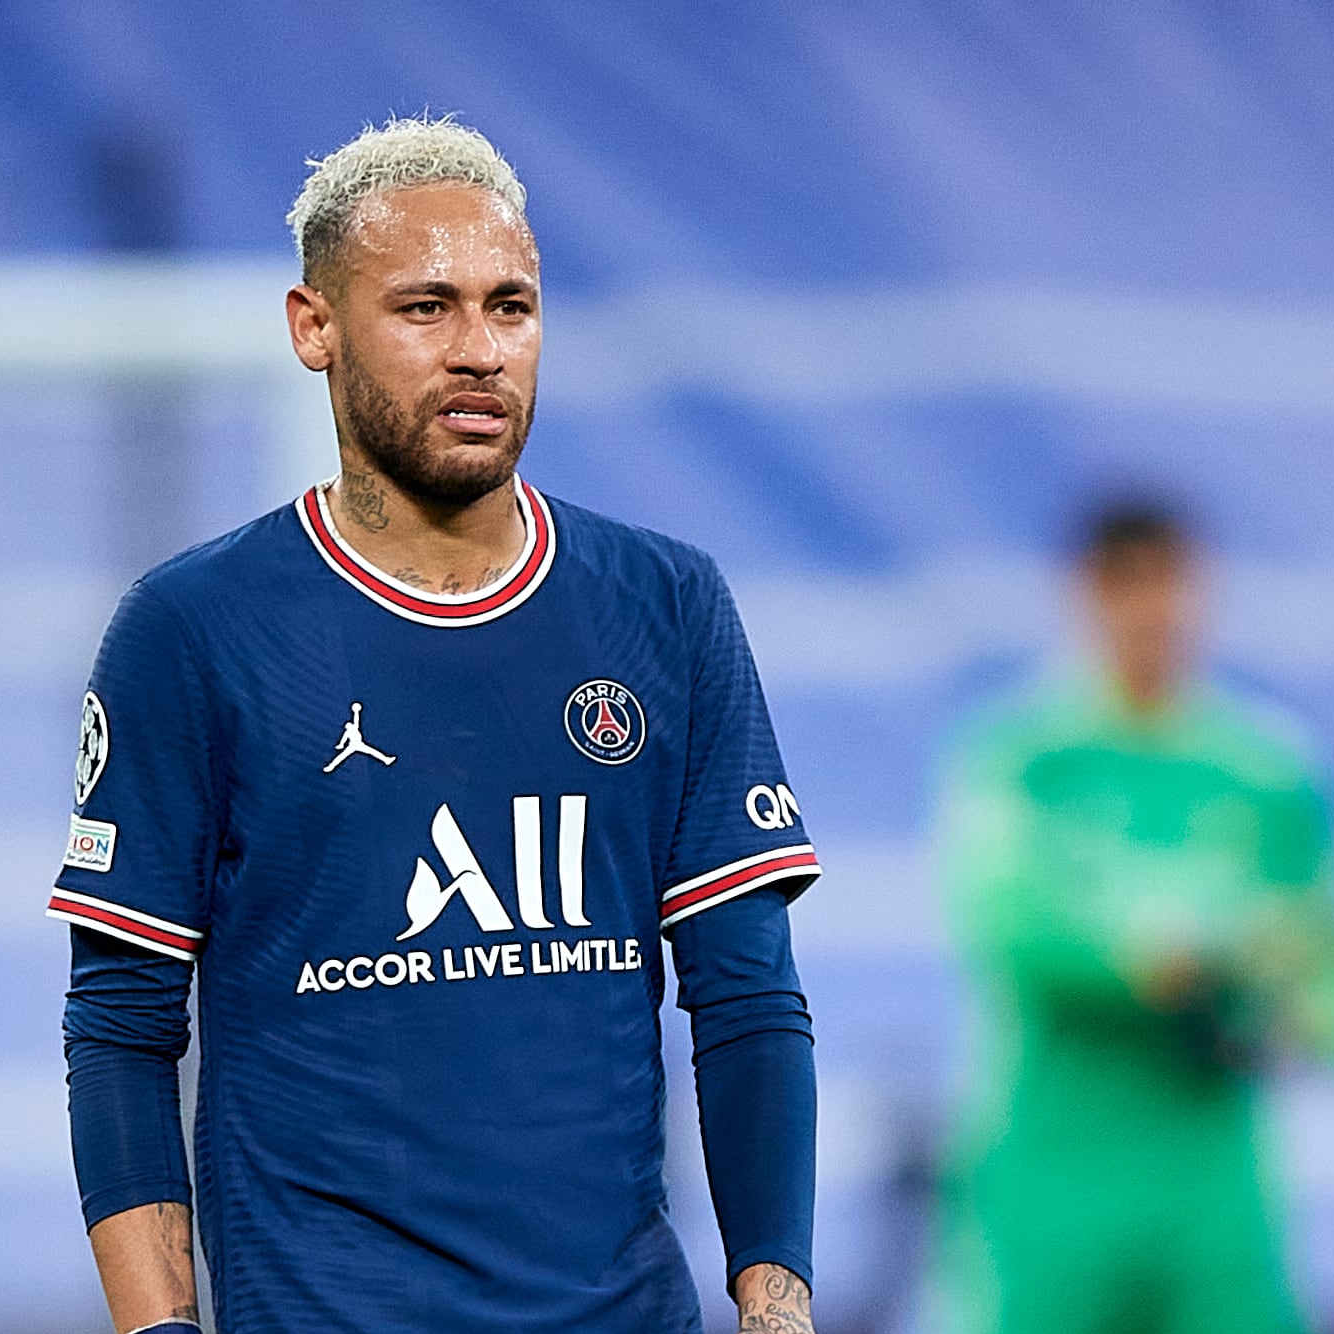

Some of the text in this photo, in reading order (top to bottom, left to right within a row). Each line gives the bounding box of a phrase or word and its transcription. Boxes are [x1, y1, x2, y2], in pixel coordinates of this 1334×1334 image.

[574, 684, 628, 707] PARIS
[296, 938, 642, 994] ACCOR LIVE LIMITLE
